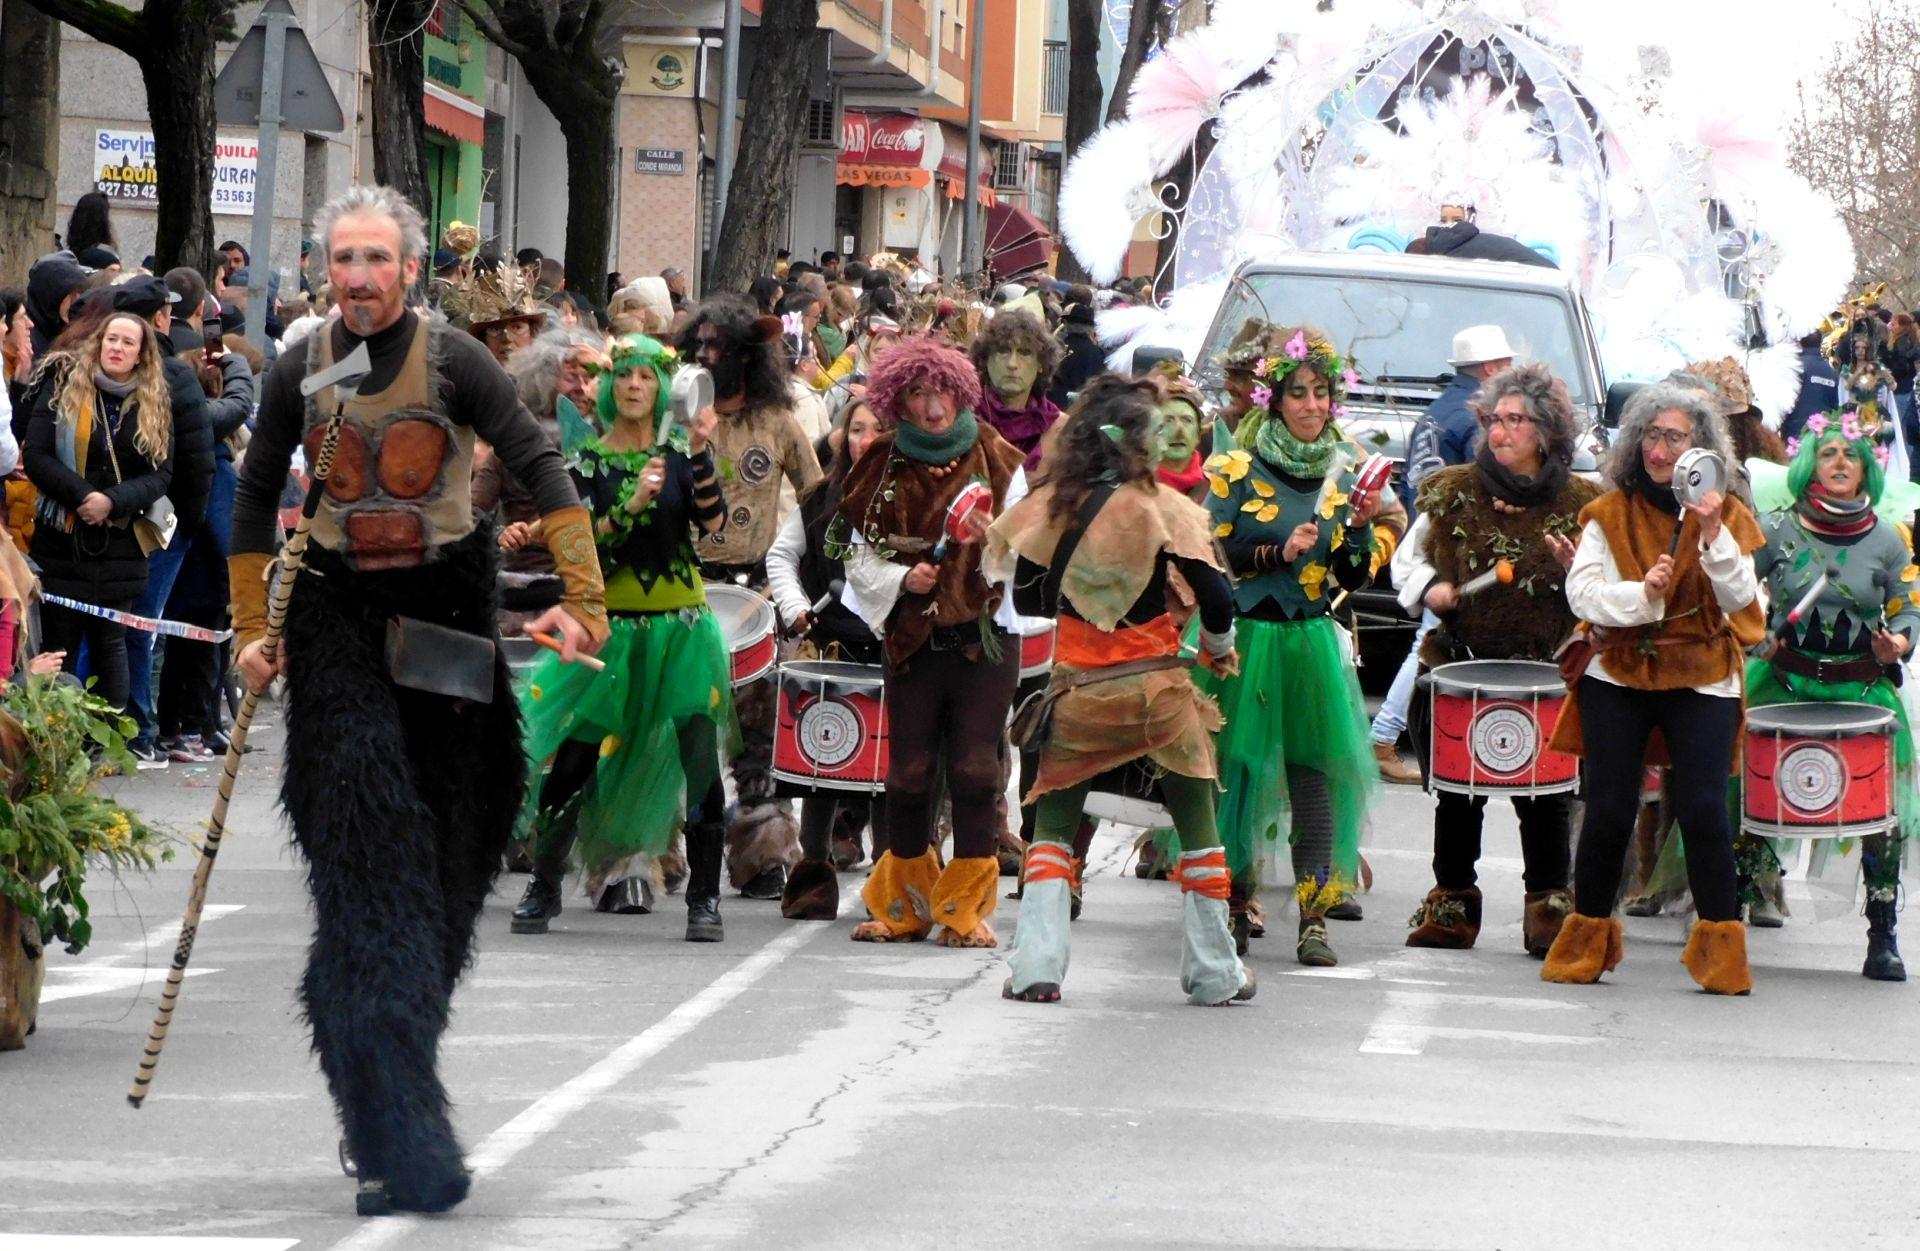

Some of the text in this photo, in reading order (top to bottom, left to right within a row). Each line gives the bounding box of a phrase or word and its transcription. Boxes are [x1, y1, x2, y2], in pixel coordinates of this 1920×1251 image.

[841, 124, 865, 153] AR
[646, 150, 675, 159] CALLE
[864, 170, 912, 182] VEGAS
[123, 184, 139, 198] 53
